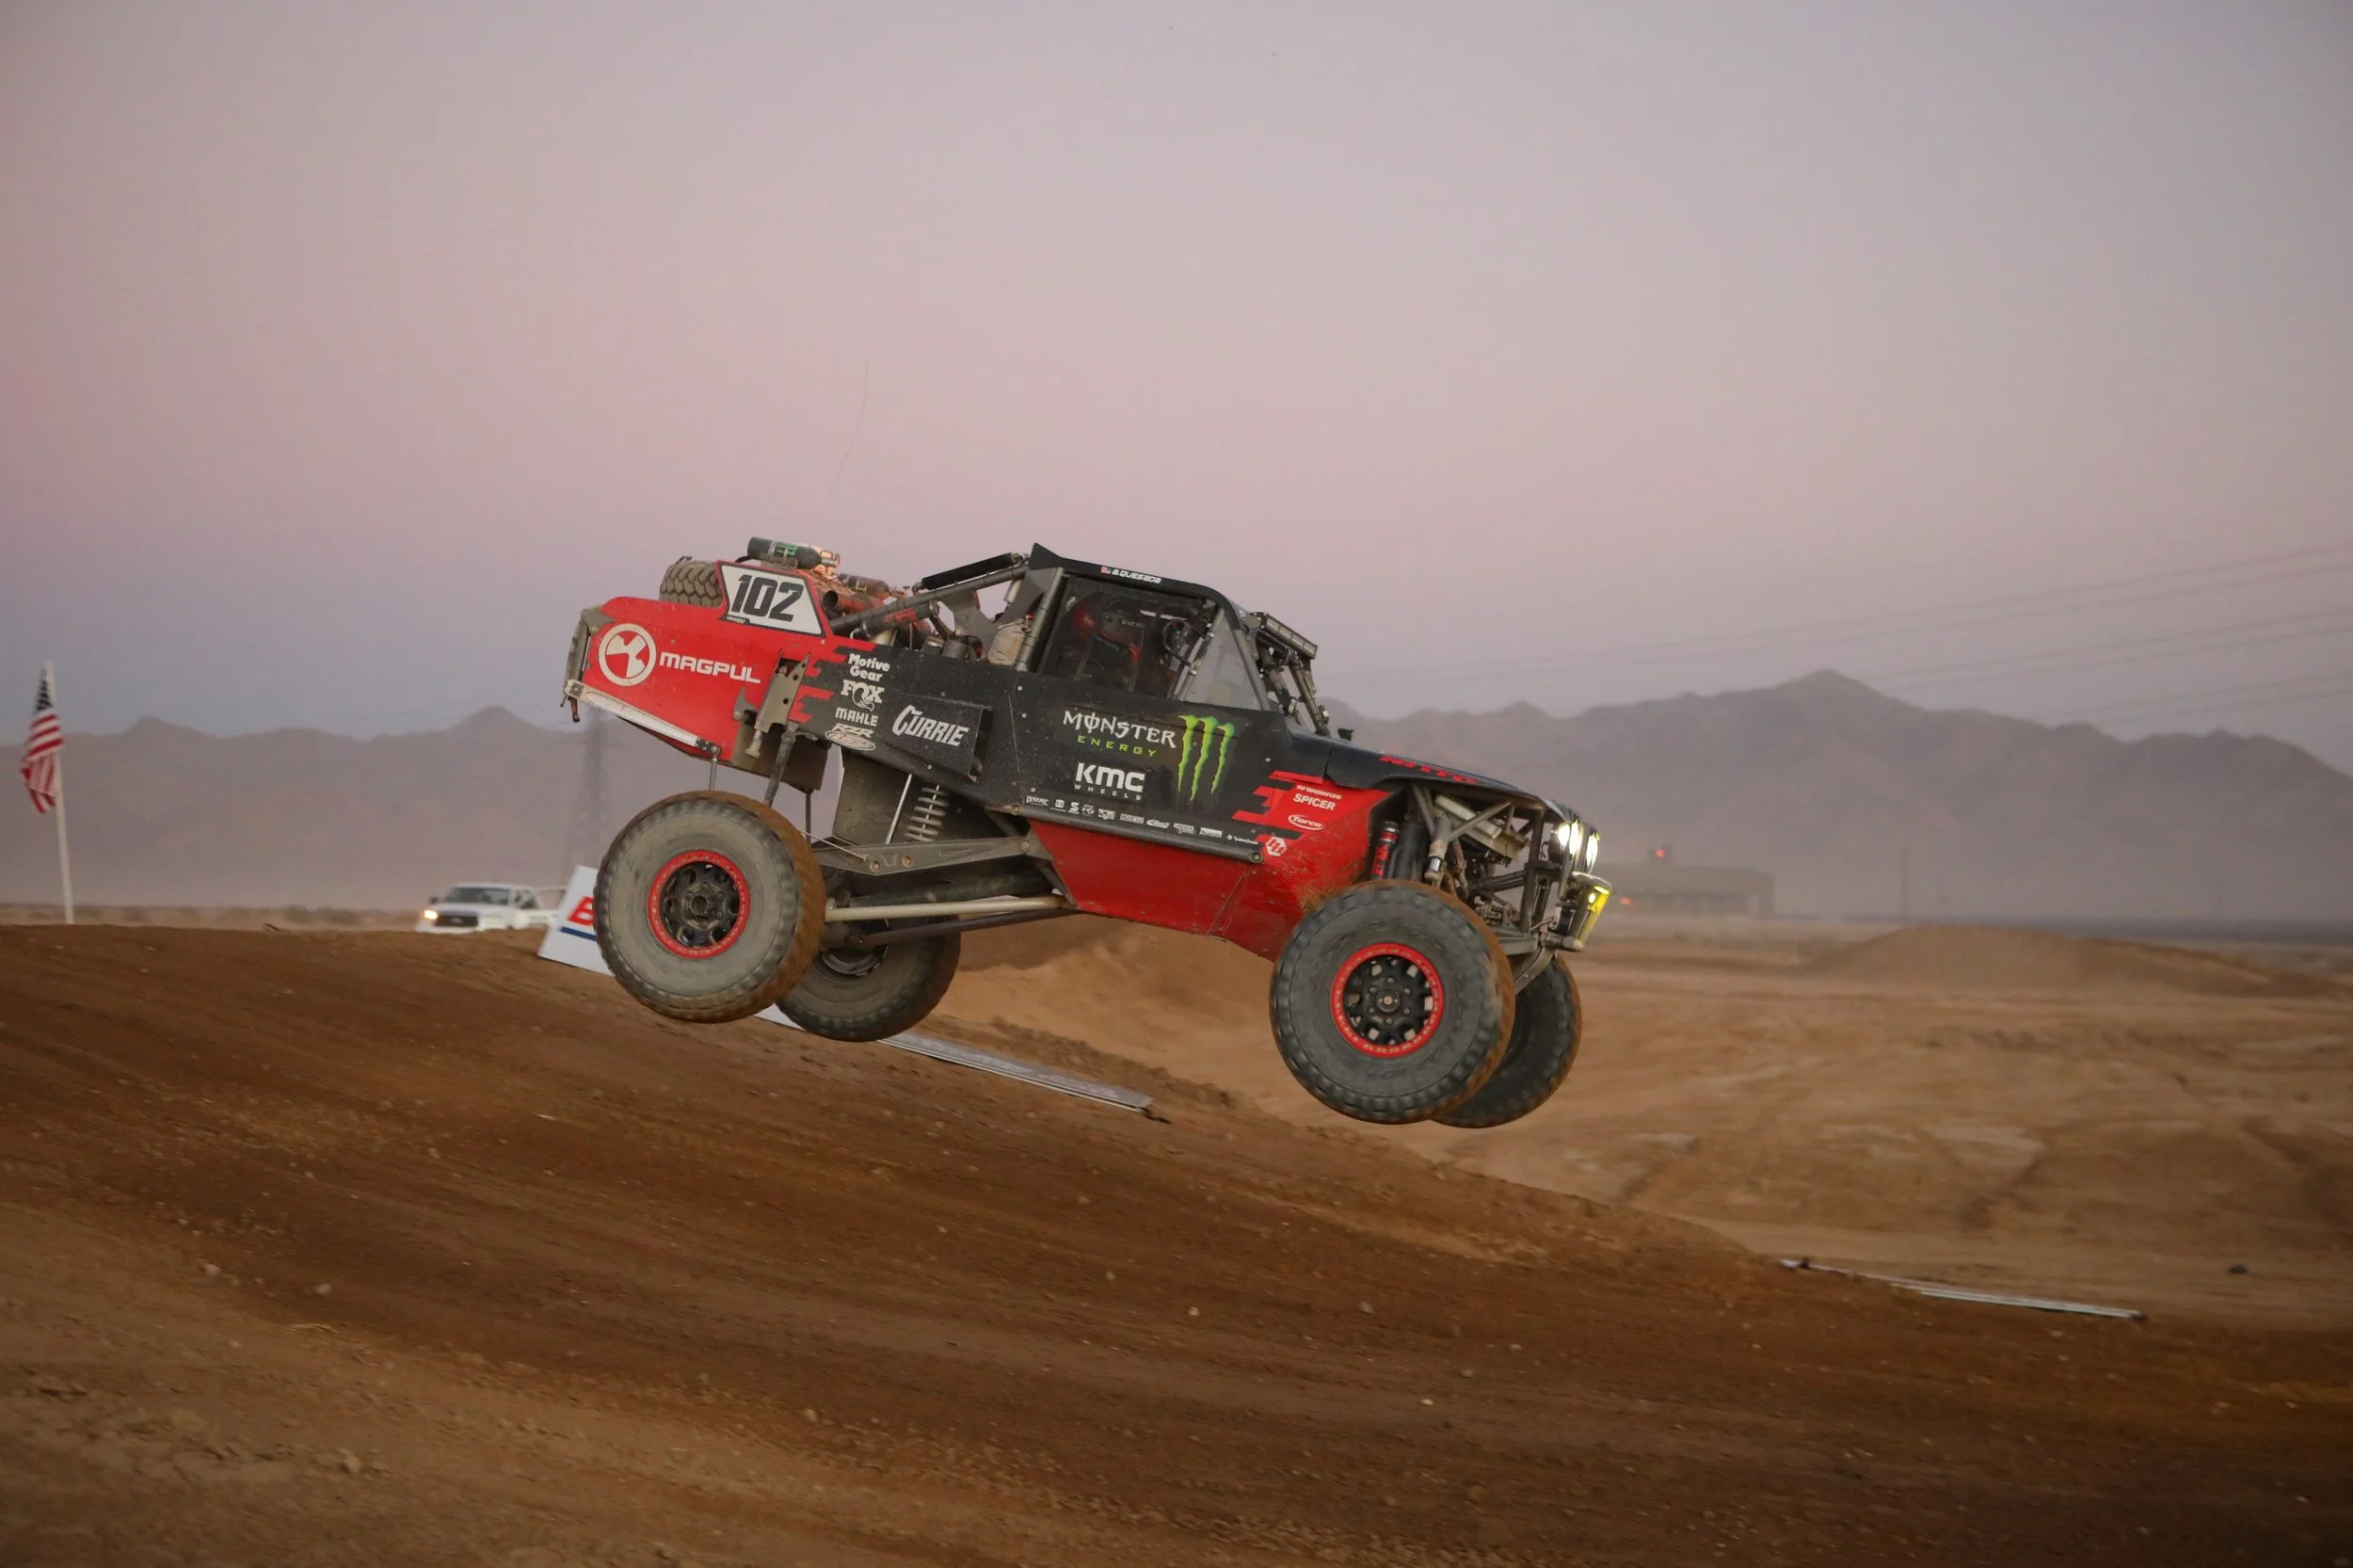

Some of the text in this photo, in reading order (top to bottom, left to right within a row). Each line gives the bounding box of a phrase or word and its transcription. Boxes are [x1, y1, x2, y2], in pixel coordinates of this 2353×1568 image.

[730, 574, 804, 622] 102
[659, 651, 760, 684] MAGPUL
[848, 653, 890, 672] Motive
[849, 664, 883, 682] Gear
[840, 679, 885, 709] FOX
[835, 707, 879, 728] MAHLE
[1063, 711, 1176, 749] MONSTER
[1077, 735, 1157, 757] ENERGY
[1075, 762, 1145, 792] KMC
[1074, 784, 1142, 801] WHEELS
[1293, 793, 1336, 811] SPICER
